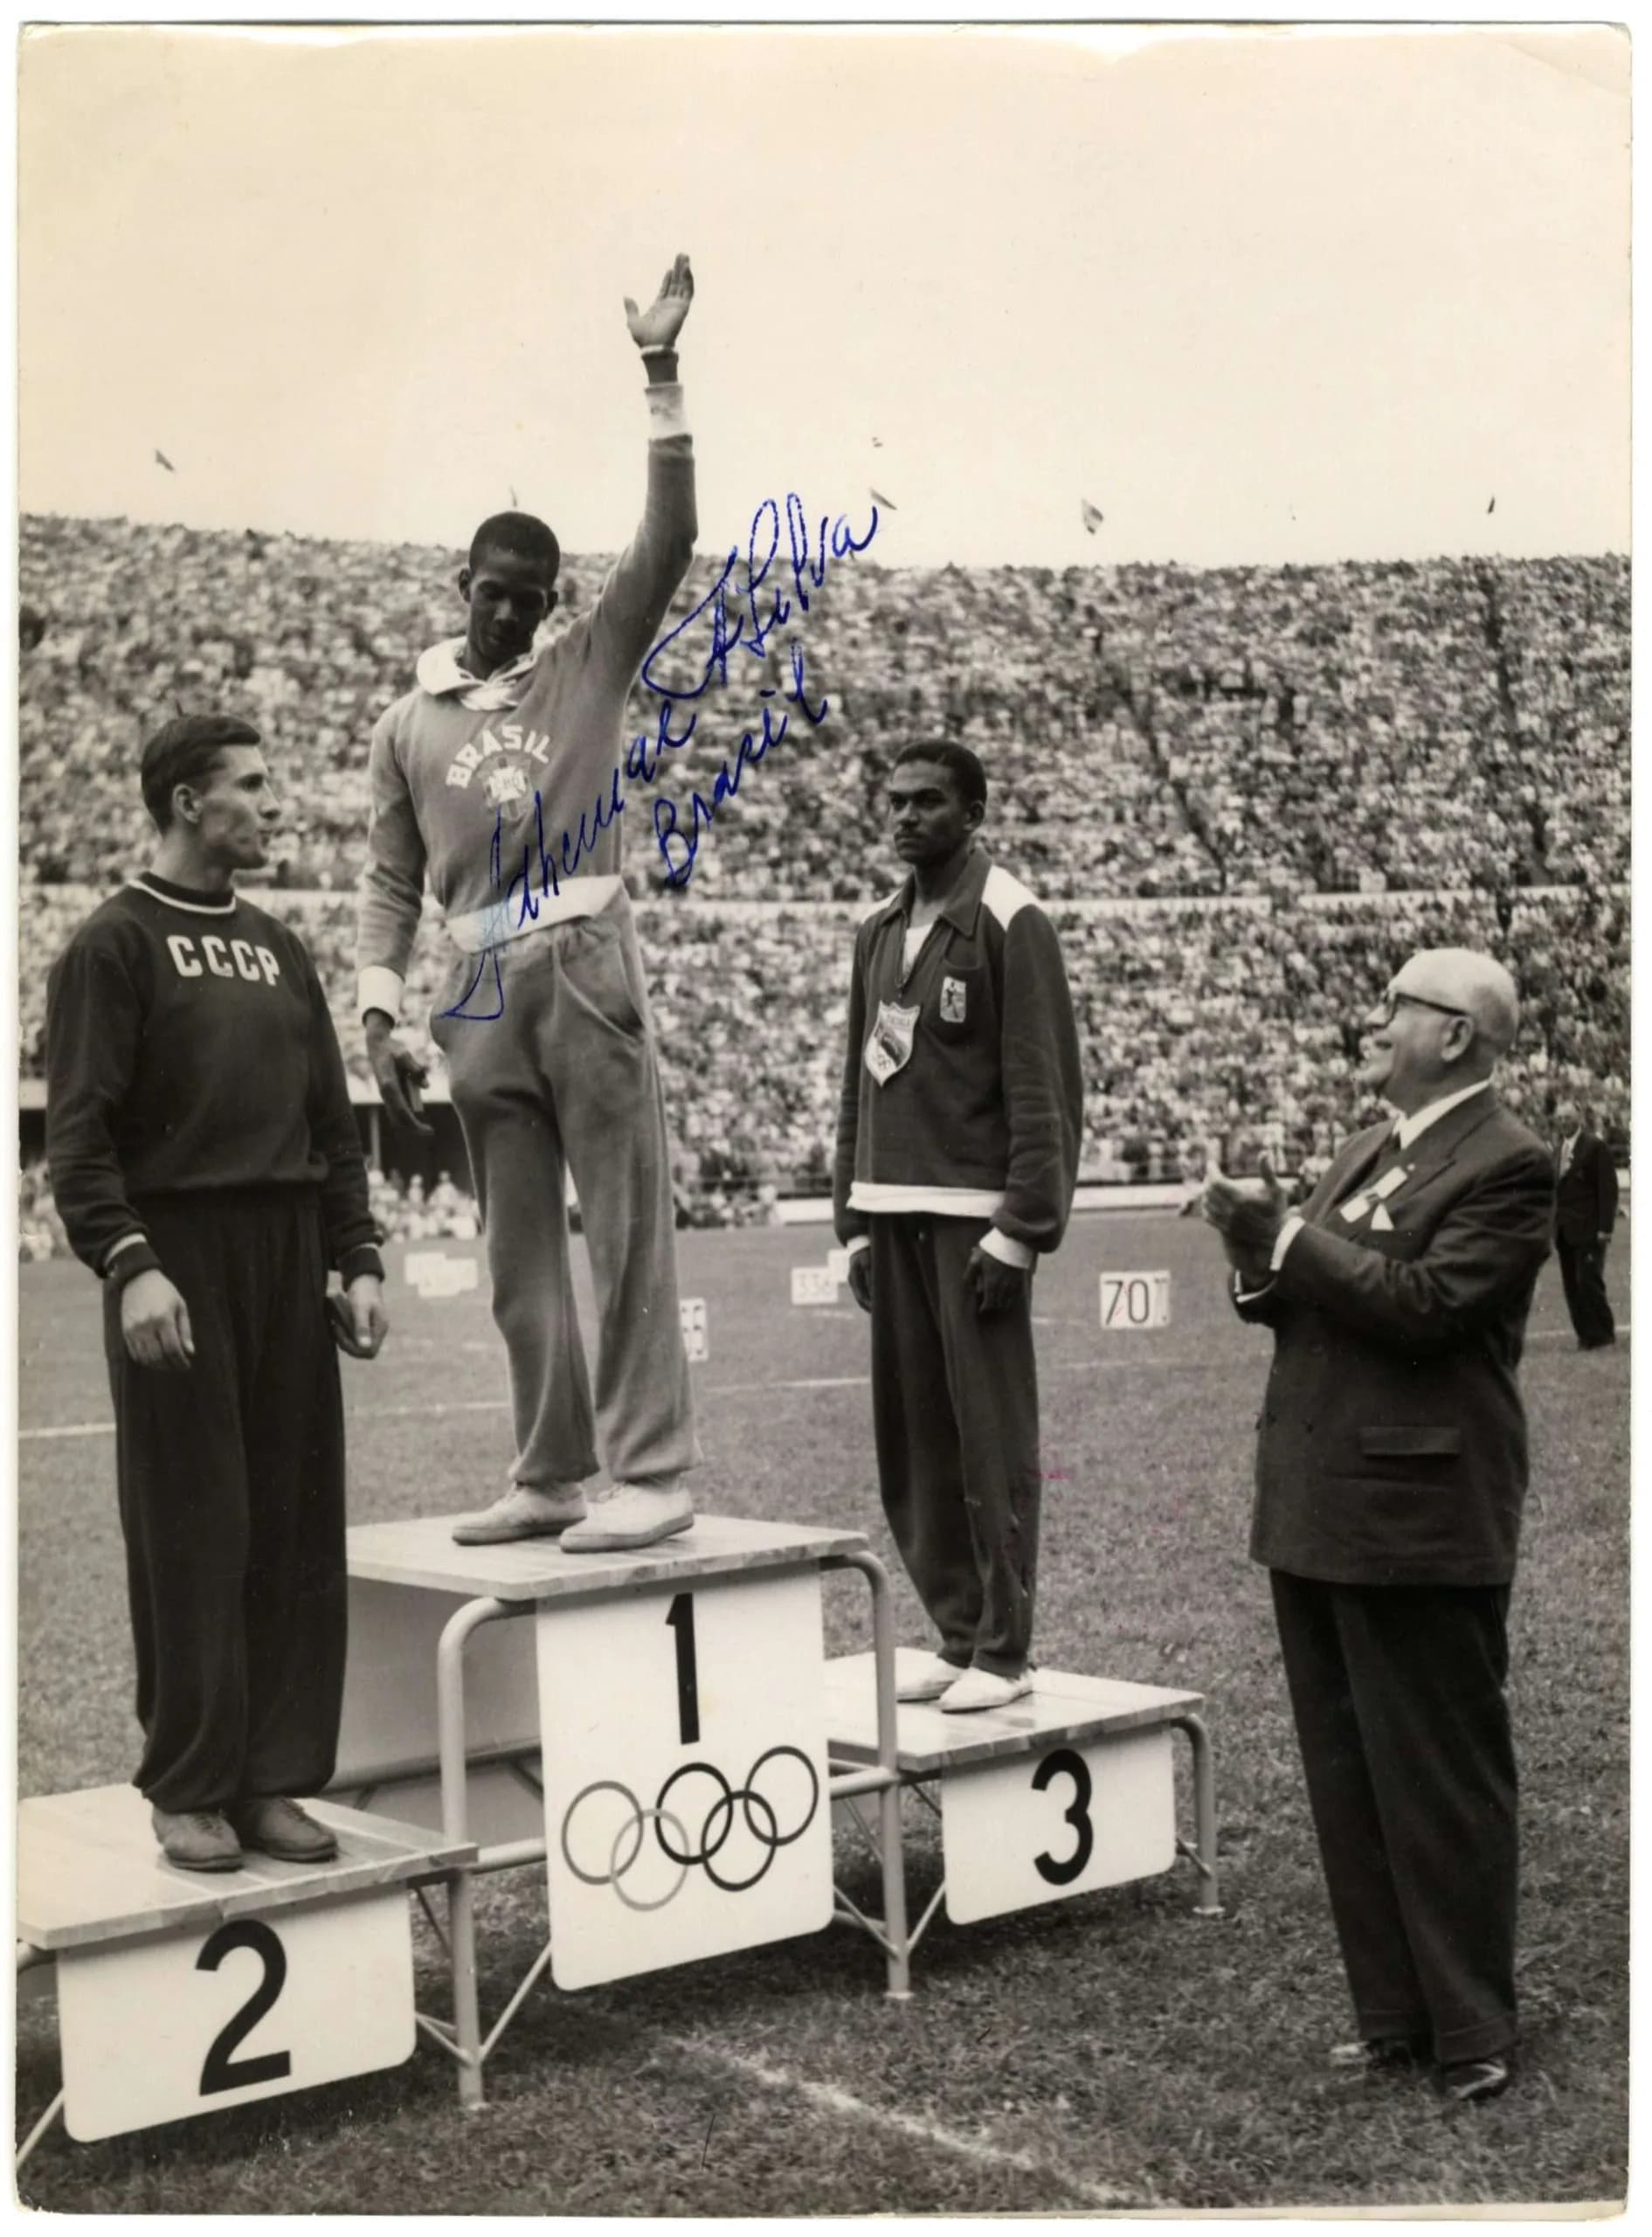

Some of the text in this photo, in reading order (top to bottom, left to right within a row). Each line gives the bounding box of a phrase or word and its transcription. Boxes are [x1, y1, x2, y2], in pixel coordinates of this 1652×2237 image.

[445, 724, 550, 788] BRASIL
[654, 636, 827, 887] Brasil
[665, 1593, 701, 1745] 1
[1031, 1749, 1094, 1886] 3
[195, 1920, 292, 2096] 2
